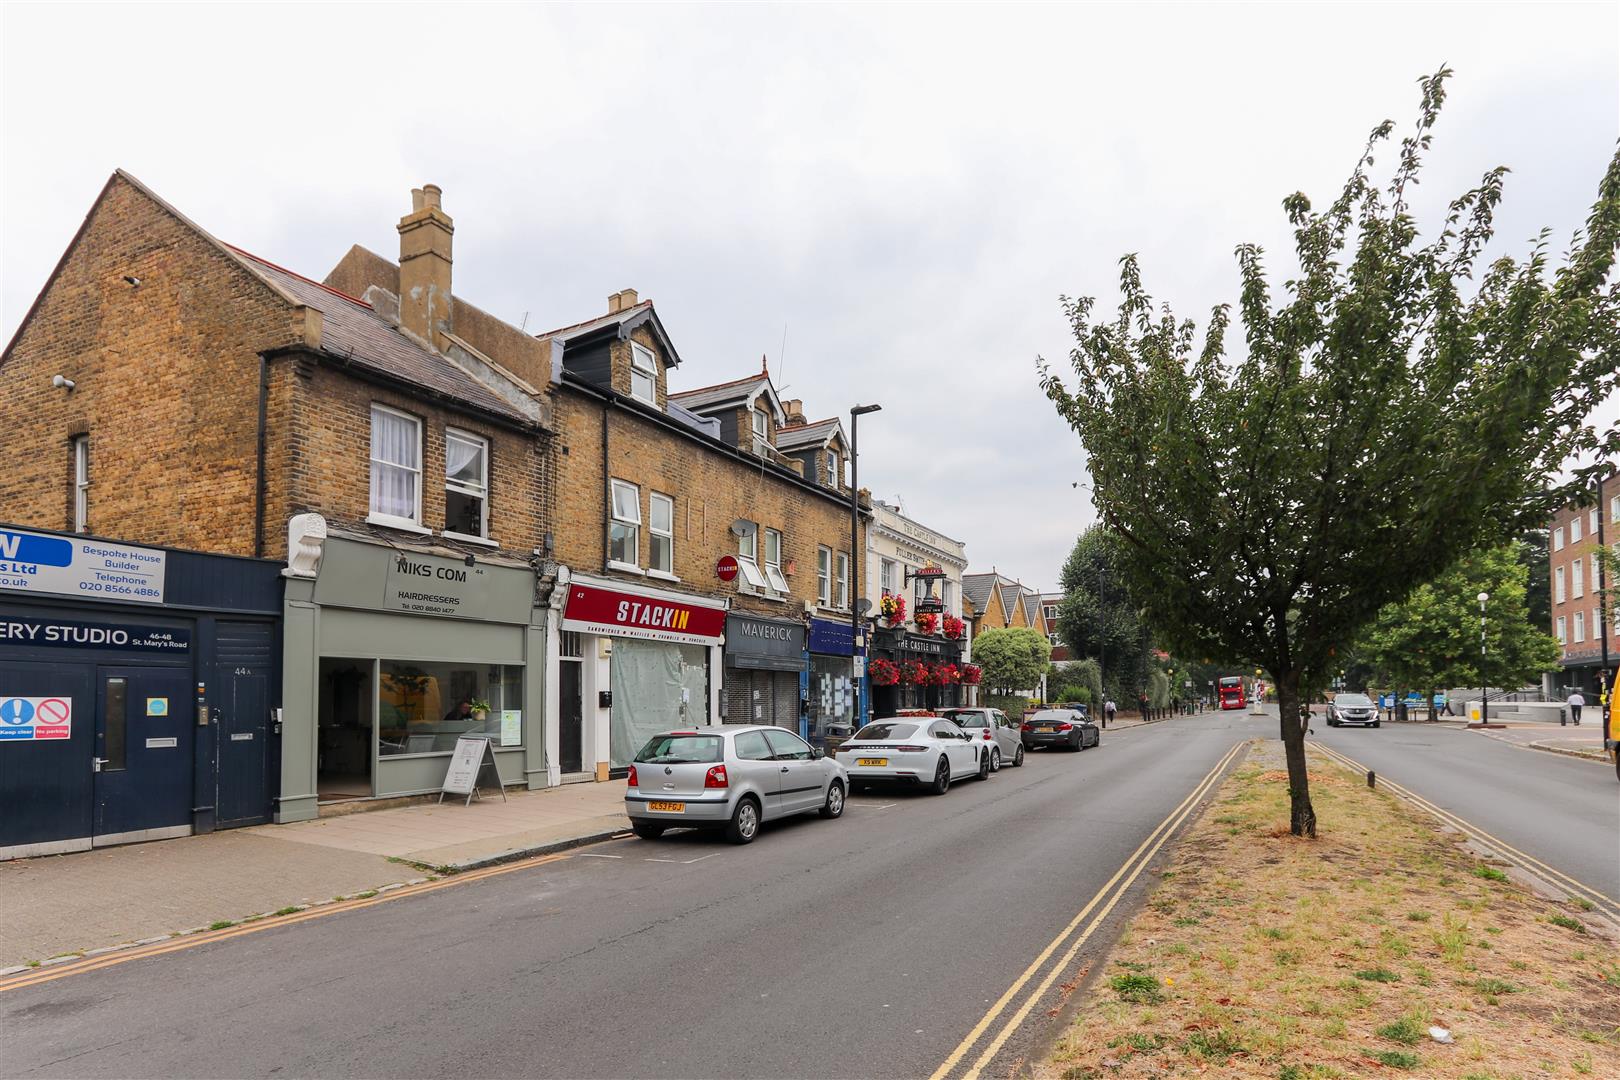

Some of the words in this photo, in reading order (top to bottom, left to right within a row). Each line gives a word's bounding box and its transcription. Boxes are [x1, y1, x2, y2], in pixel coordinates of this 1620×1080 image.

[82, 545, 128, 558] Bespoke
[130, 552, 161, 563] House
[12, 563, 37, 575] Ltd
[104, 559, 140, 571] Builder
[396, 561, 432, 577] NIKS
[436, 567, 467, 583] COM
[95, 572, 147, 585] Telephone
[80, 581, 102, 591] 020
[104, 584, 131, 594] 8566
[133, 588, 160, 597] 4886
[398, 591, 460, 605] HAIRDRESSERS
[616, 600, 690, 630] STACKIN
[45, 625, 128, 645] STUDIO
[741, 622, 792, 641] MAVERICK
[144, 639, 168, 648] Mary's
[910, 640, 929, 652] CASTLE
[930, 644, 940, 652] INN
